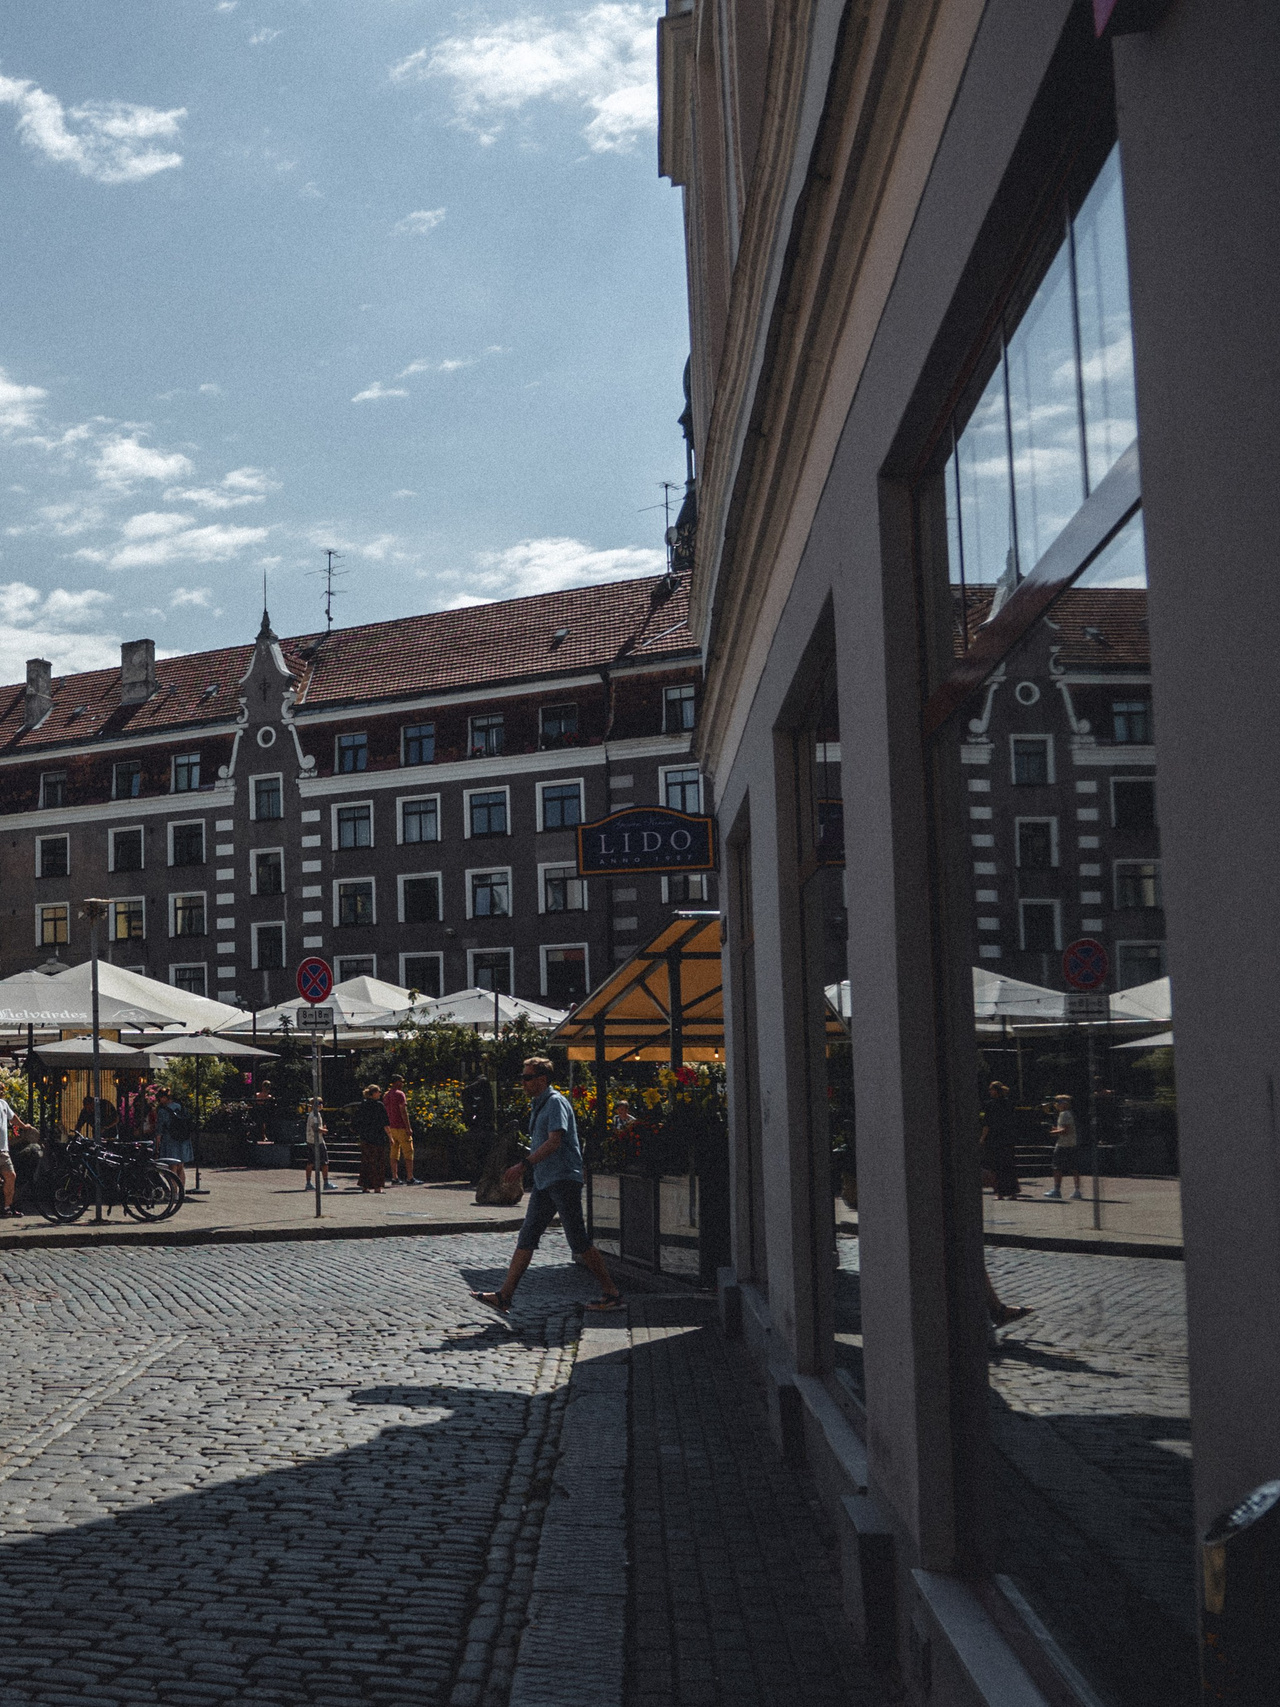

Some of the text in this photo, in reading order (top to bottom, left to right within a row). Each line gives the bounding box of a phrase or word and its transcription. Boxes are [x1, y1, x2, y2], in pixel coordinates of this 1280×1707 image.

[599, 829, 692, 855] LIDO
[599, 854, 692, 865] ANNO 1987
